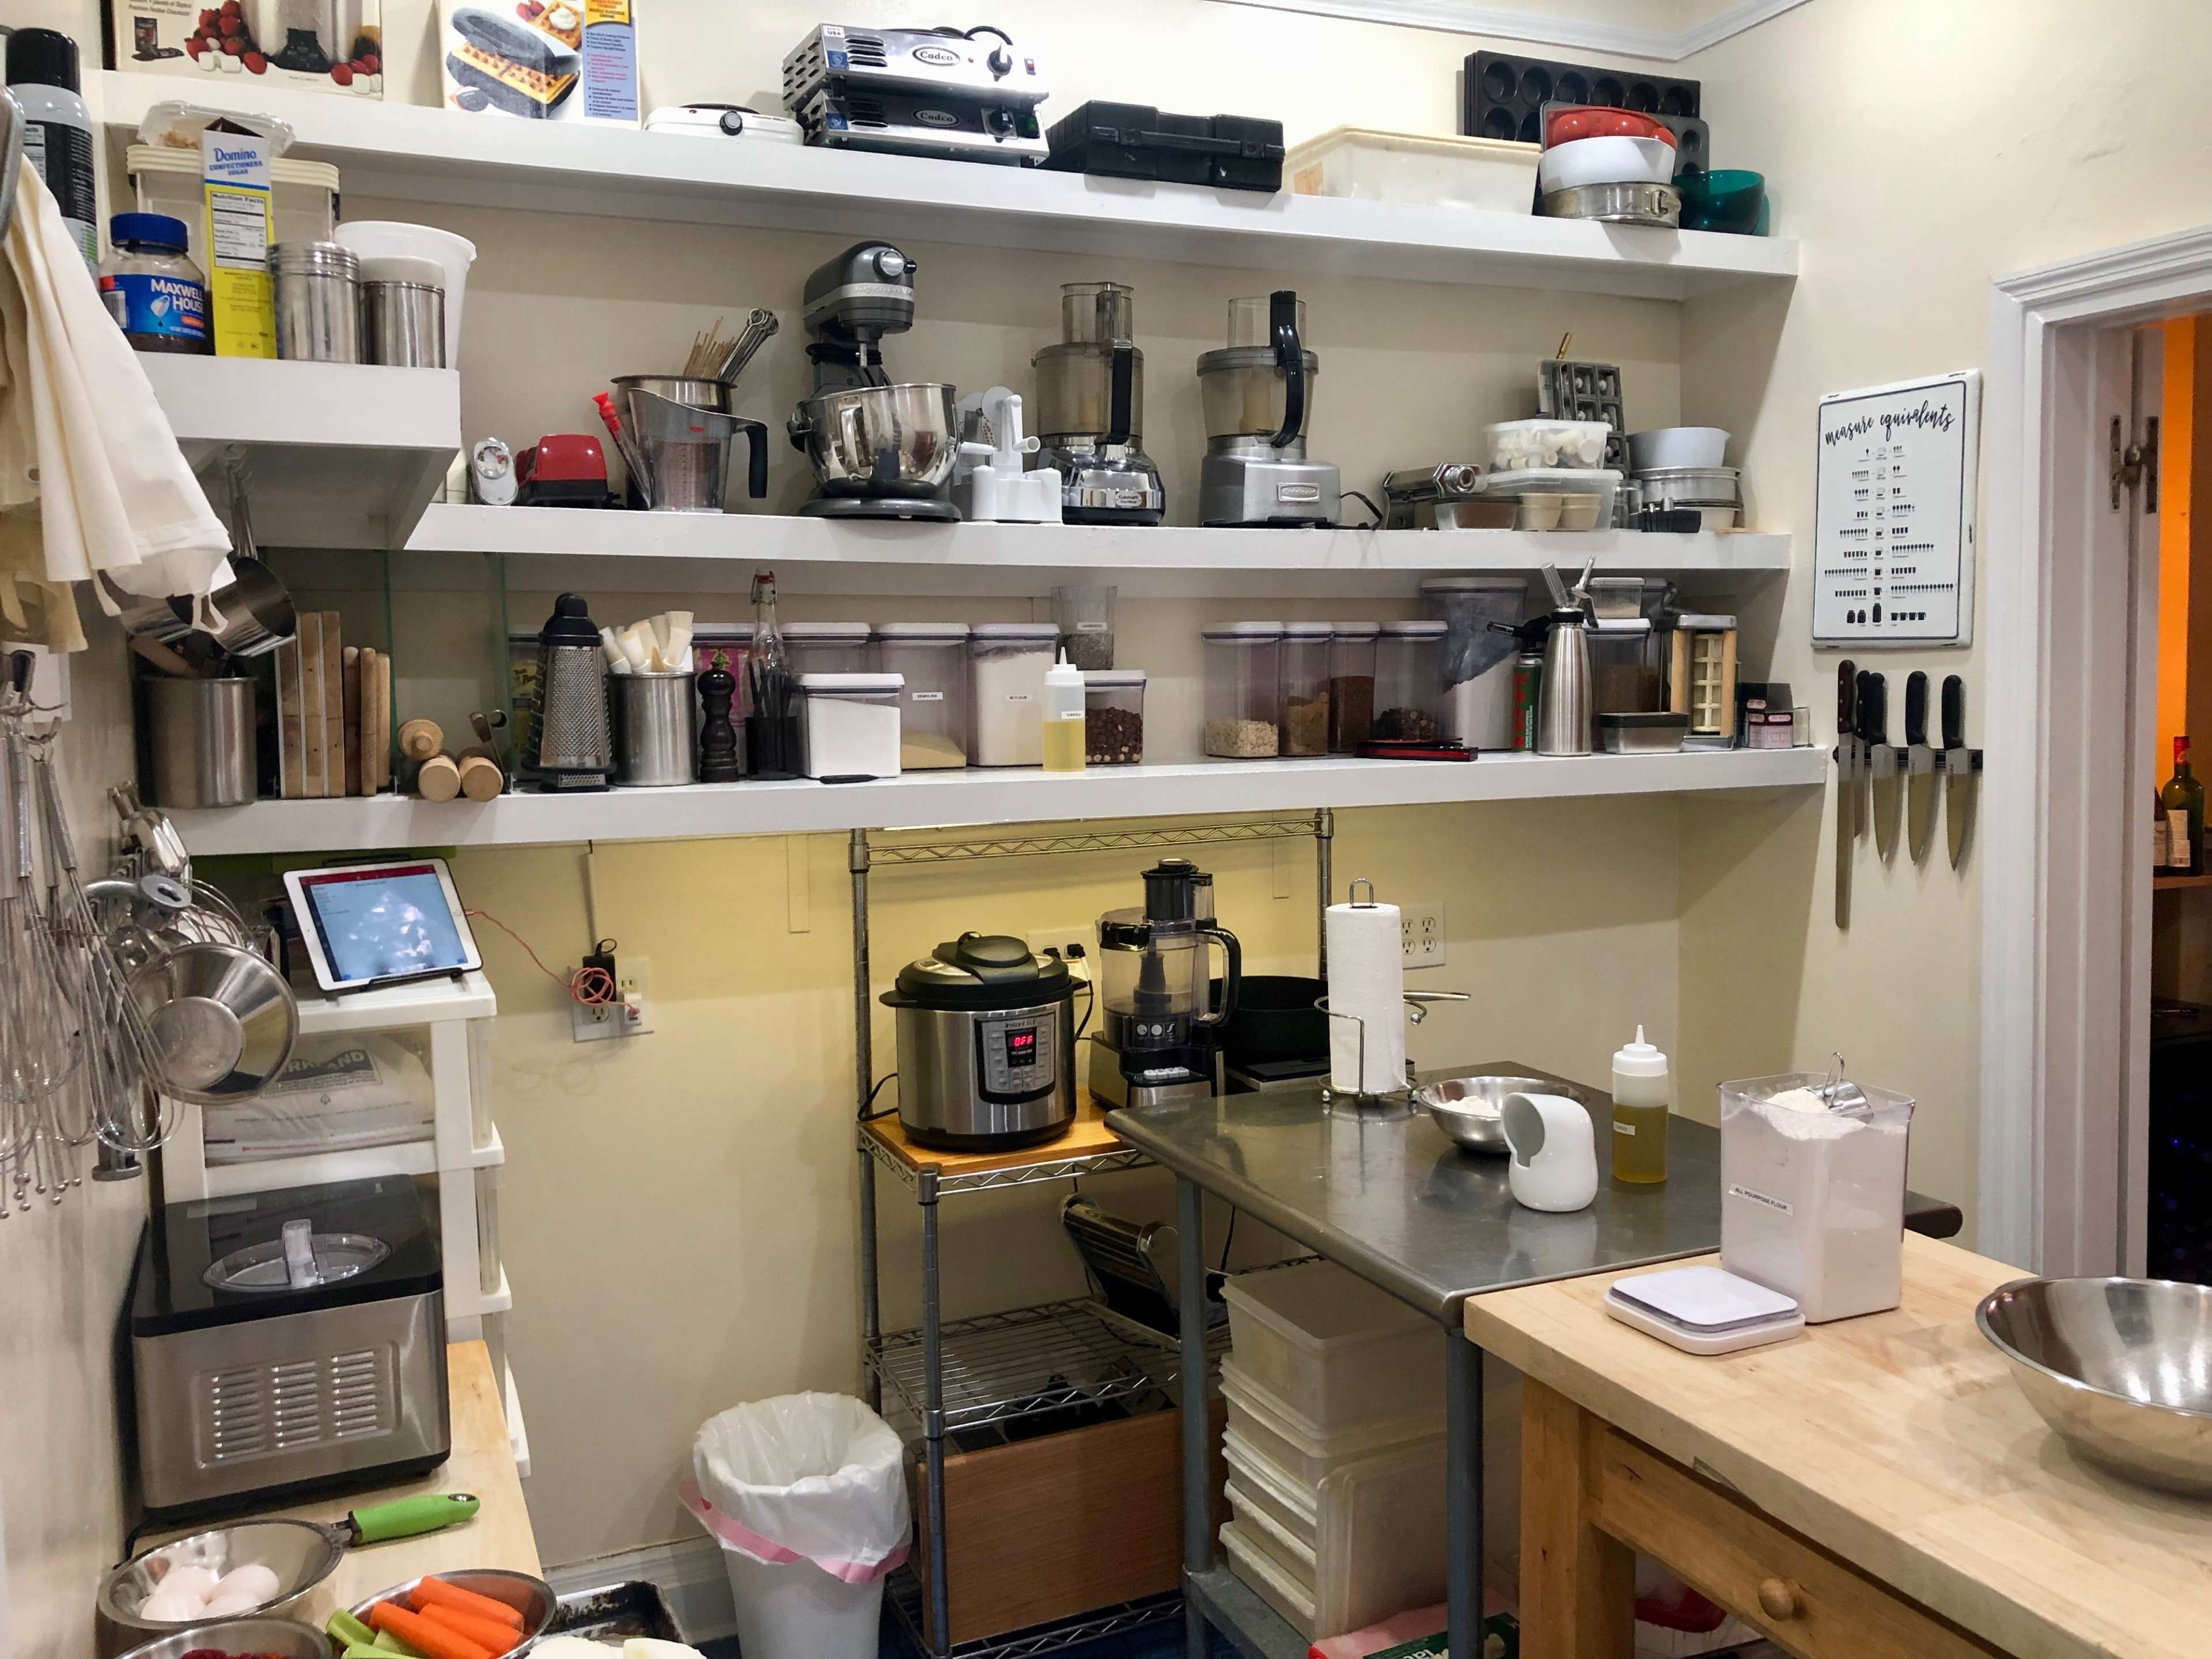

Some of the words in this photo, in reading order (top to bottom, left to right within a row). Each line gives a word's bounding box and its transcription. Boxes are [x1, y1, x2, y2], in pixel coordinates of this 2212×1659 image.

[920, 51, 953, 61] Cadco
[920, 112, 953, 122] Cadco
[213, 147, 257, 162] Domino
[212, 193, 243, 201] Nutrition
[150, 278, 203, 302] MAXWELL
[1825, 415, 1874, 446] measure
[1880, 400, 1955, 442] equivalents
[1513, 672, 1529, 747] SUPER
[1014, 1035, 1033, 1047] OFF
[1745, 1190, 1770, 1205] POURPOSE
[1771, 1200, 1787, 1210] FLOUR
